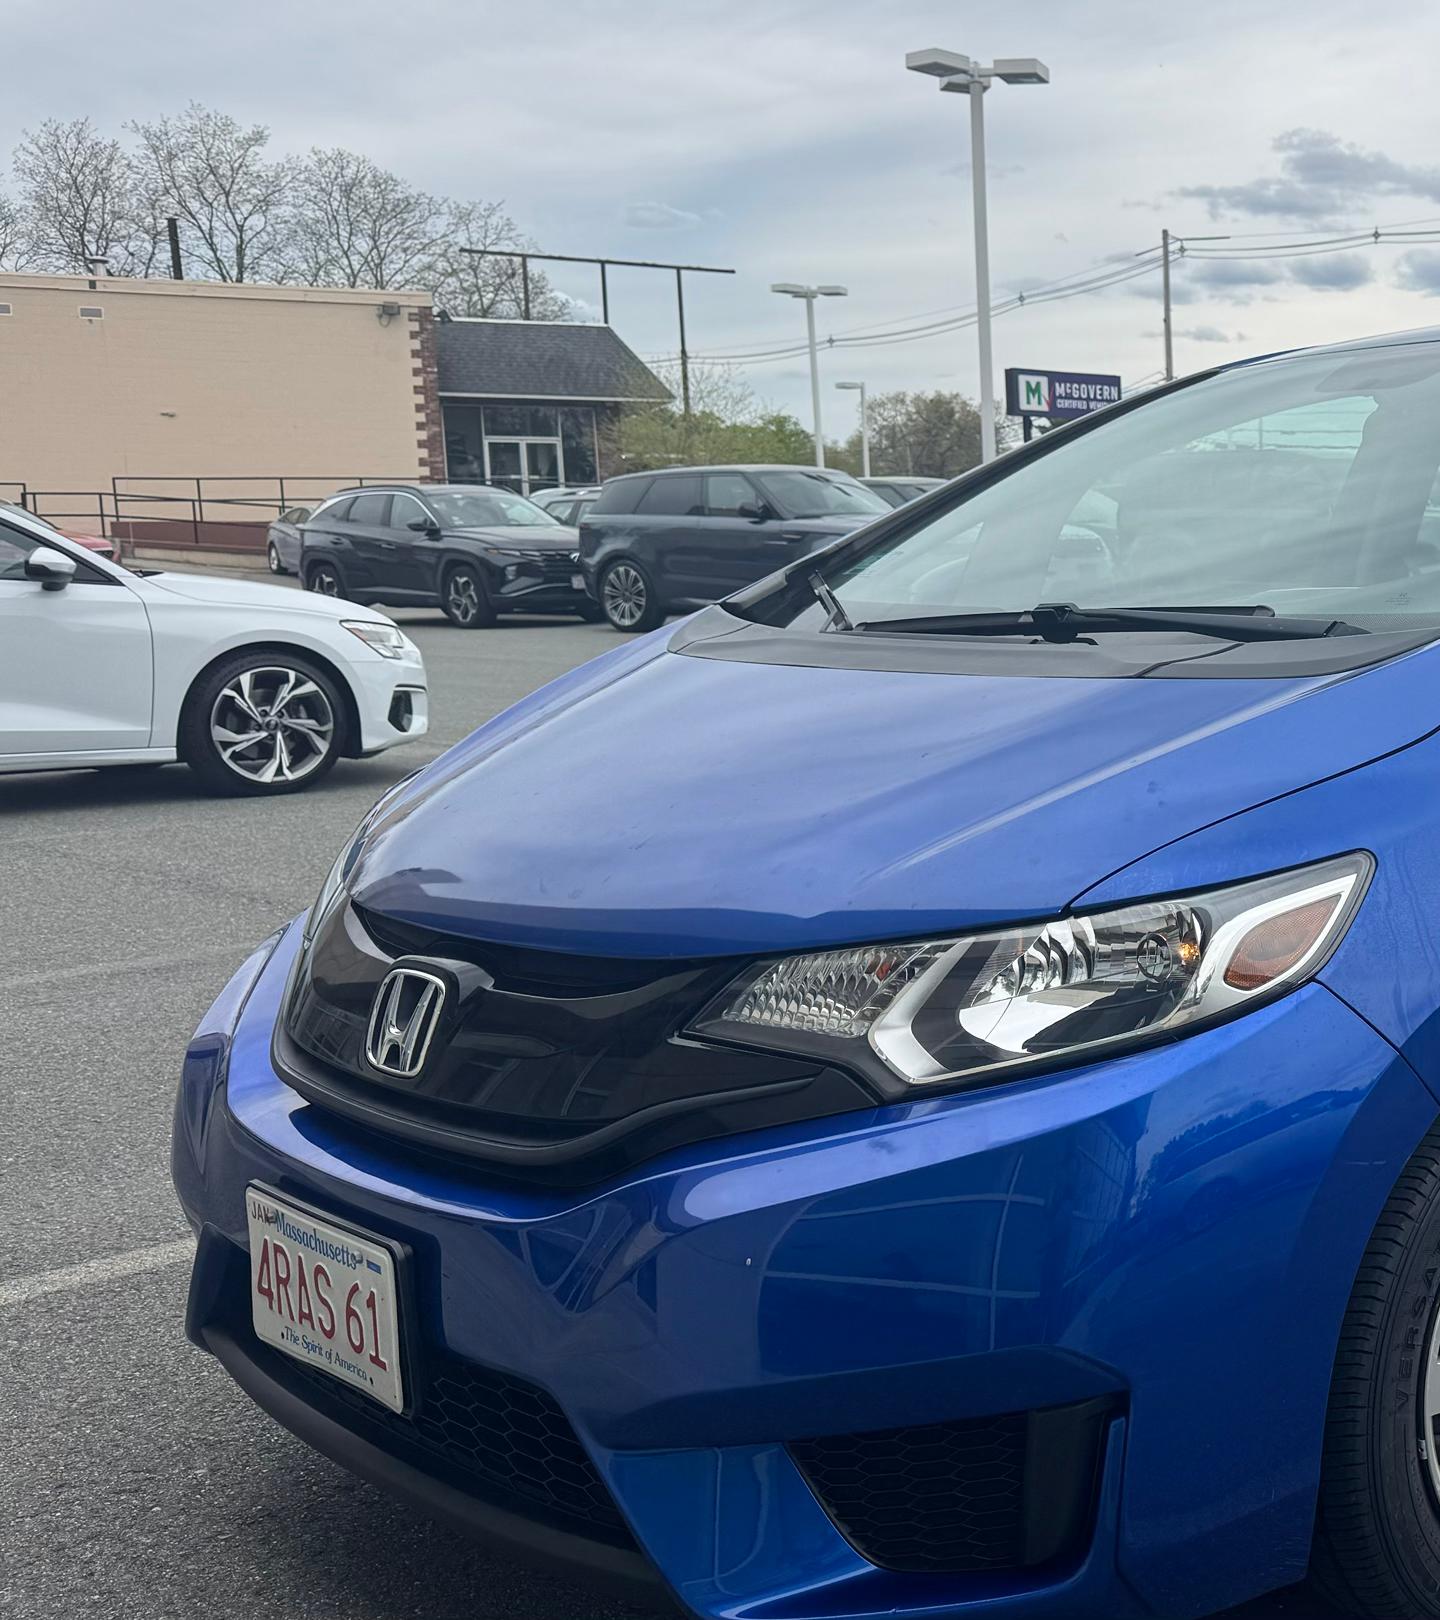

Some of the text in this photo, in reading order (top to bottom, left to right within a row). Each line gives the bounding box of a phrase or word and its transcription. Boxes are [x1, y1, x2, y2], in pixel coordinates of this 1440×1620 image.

[1056, 399, 1088, 410] CERTIFIED
[252, 1201, 270, 1225] JAN
[275, 1209, 357, 1271] Massachusetts
[256, 1237, 388, 1372] 4RAS 61
[284, 1325, 368, 1381] The Spirit of America
